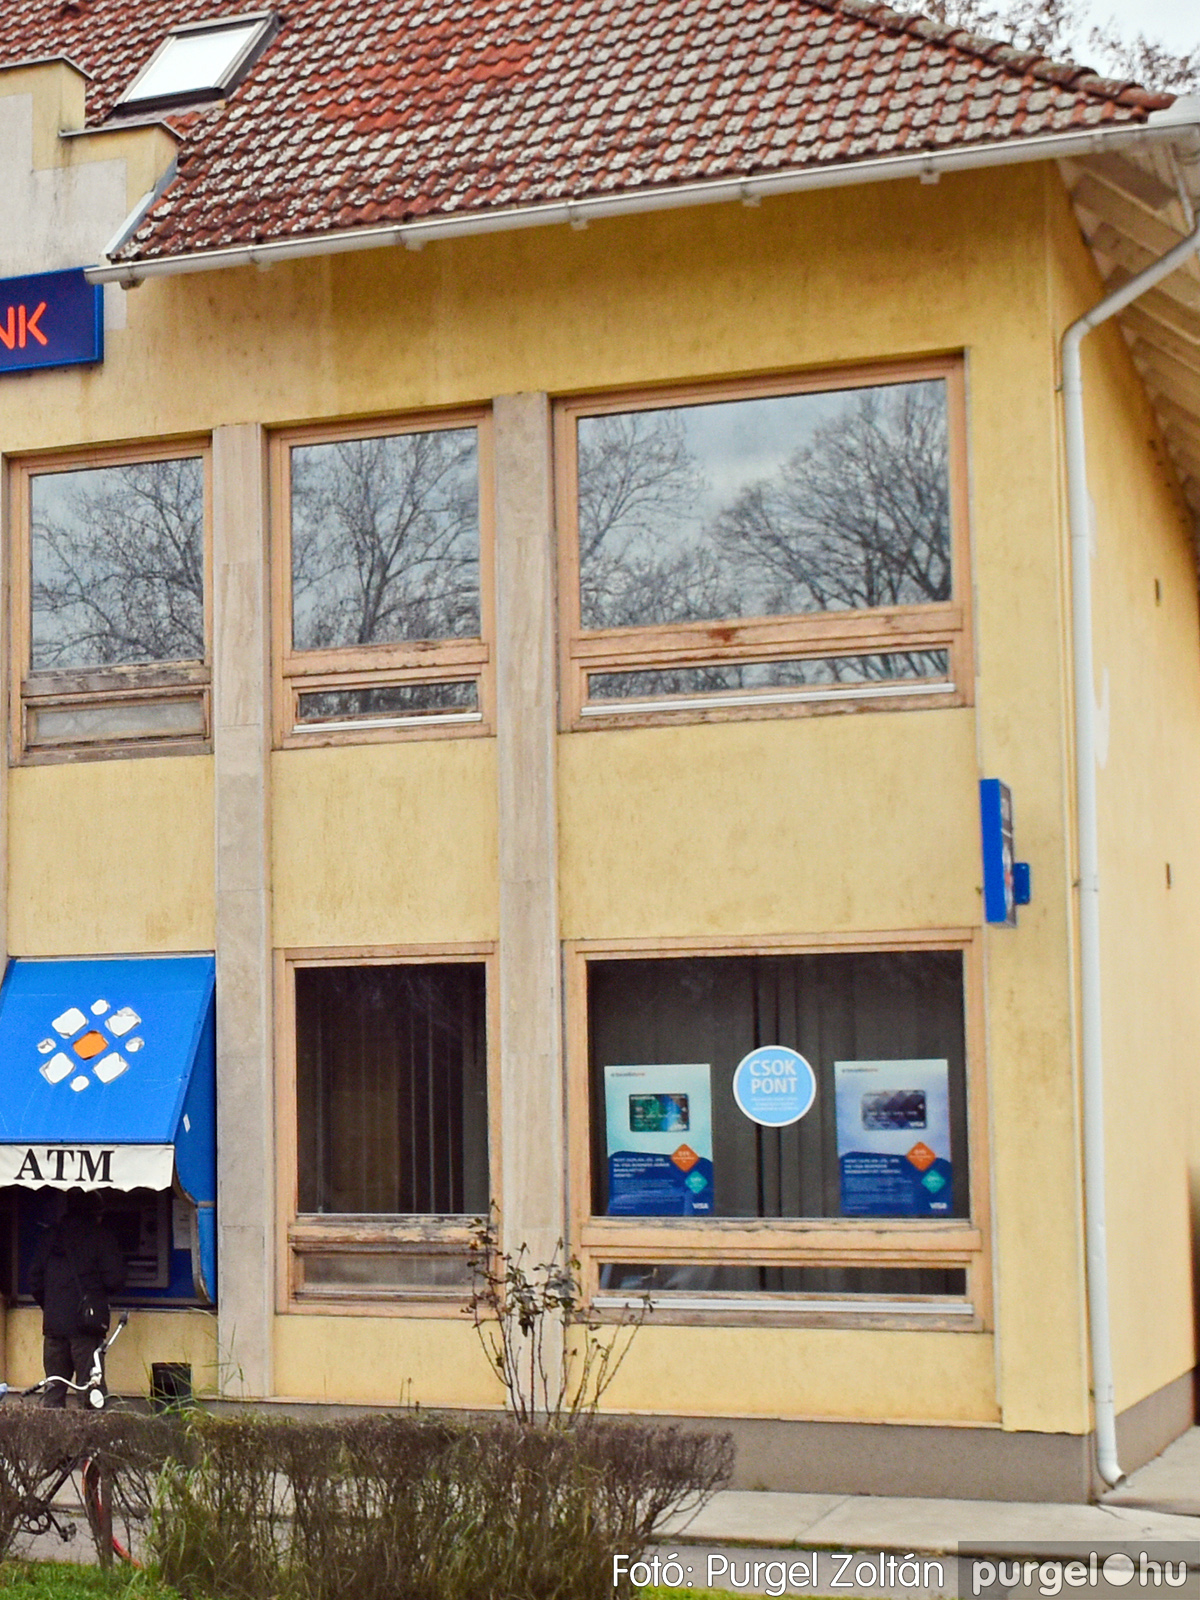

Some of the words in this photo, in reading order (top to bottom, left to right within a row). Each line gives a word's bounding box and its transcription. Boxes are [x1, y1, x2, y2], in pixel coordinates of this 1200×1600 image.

[749, 1059, 797, 1076] CSOK
[751, 1077, 798, 1094] PONT
[14, 1148, 115, 1183] ATM
